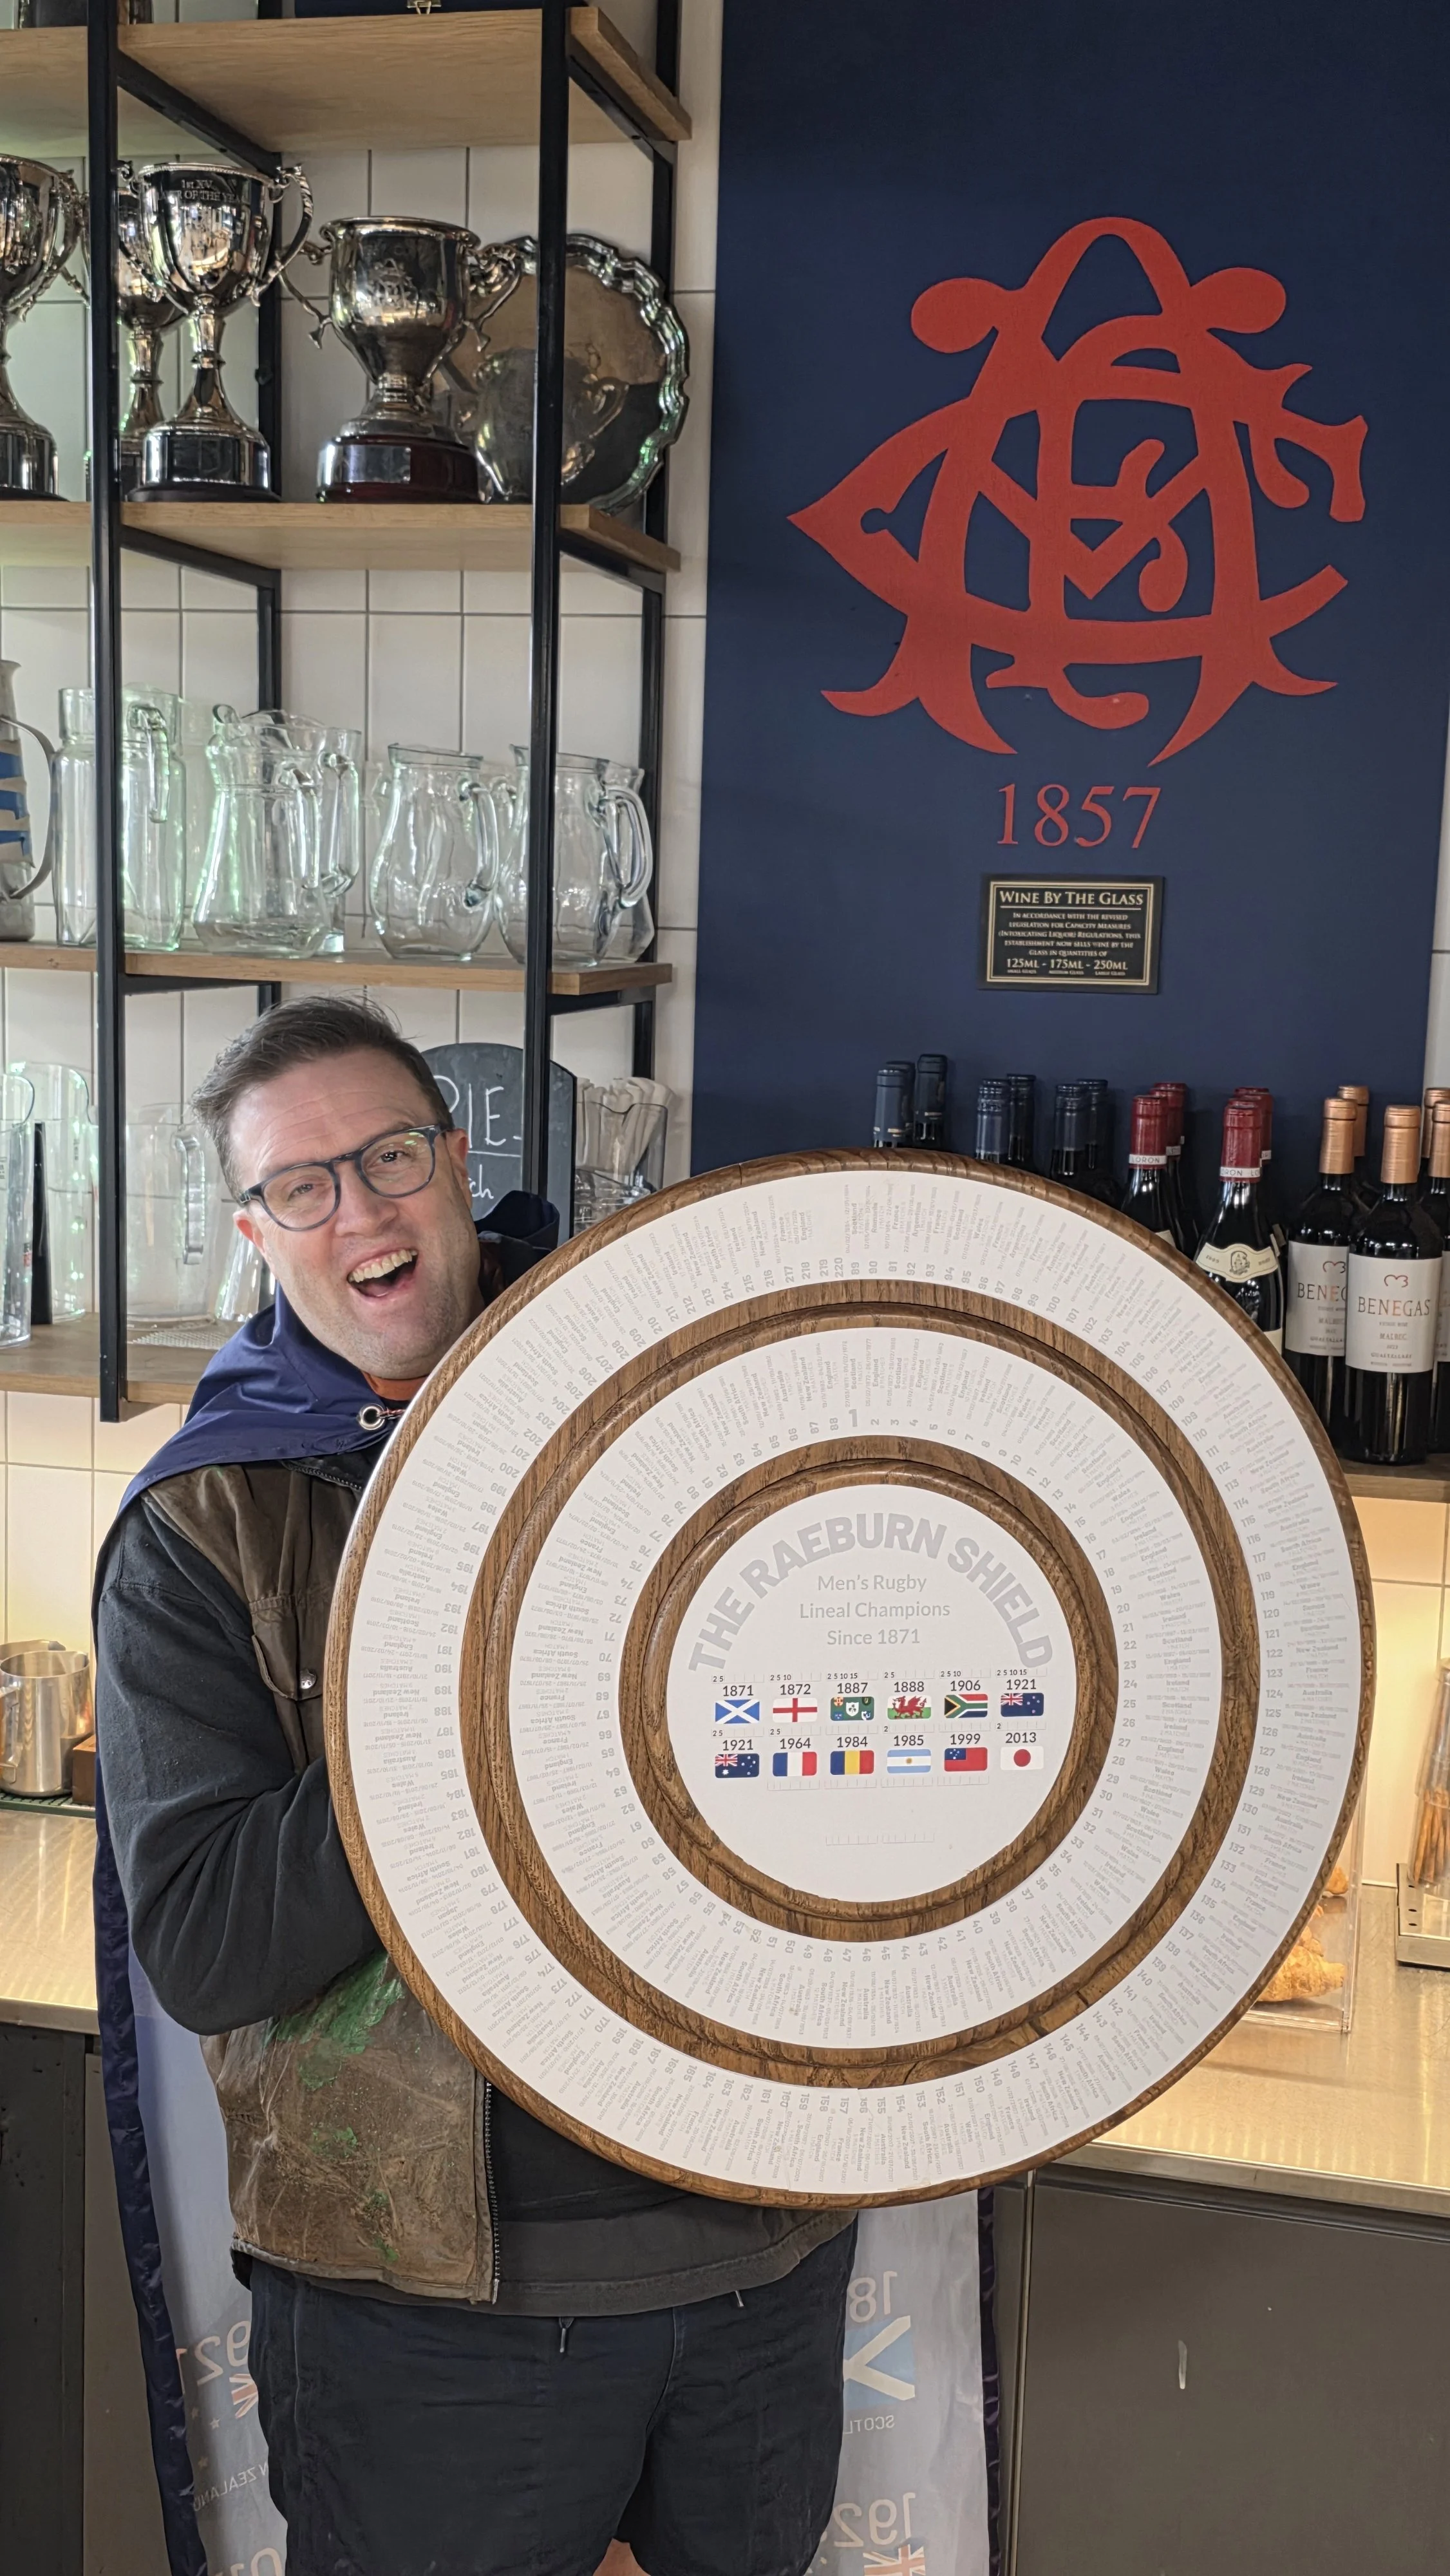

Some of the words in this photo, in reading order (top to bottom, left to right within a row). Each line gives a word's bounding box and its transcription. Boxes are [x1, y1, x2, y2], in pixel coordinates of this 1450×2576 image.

[200, 191, 220, 201] THE
[997, 783, 1161, 848] 1857
[1000, 891, 1039, 904] WINE
[1044, 891, 1062, 904] BY
[1065, 891, 1095, 905] THE
[1099, 892, 1143, 905] GLASS
[801, 1262, 811, 1280] 218
[819, 1260, 828, 1276] 219
[834, 1258, 843, 1278] 220
[851, 1262, 860, 1274] 89
[869, 1261, 878, 1274] 90
[907, 1263, 916, 1275] 92
[764, 1270, 774, 1287] 216
[784, 1266, 794, 1283] 217
[721, 1282, 733, 1300] 214
[1297, 1283, 1346, 1302] BENE
[1357, 1296, 1431, 1317] BENEGAS
[1142, 1367, 1158, 1382] 106
[471, 1521, 489, 1535] 197
[629, 1560, 643, 1572] 75
[451, 1582, 468, 1595] 194
[818, 1575, 869, 1590] Men's
[874, 1574, 927, 1593] Rugby
[688, 1587, 754, 1672] THE
[739, 1512, 947, 1599] RAEBURN
[947, 1537, 1053, 1669] SHIELD
[800, 1602, 850, 1618] Lineal
[855, 1601, 950, 1620] Champions
[827, 1630, 872, 1645] Since
[878, 1629, 919, 1643] 1871
[599, 1653, 612, 1662] 70
[1266, 1669, 1283, 1678] 123
[723, 1685, 753, 1696] 1871
[780, 1684, 811, 1695] 1872
[838, 1683, 868, 1694] 1887
[894, 1681, 924, 1692] 1888
[950, 1680, 981, 1691] 1906
[1007, 1679, 1036, 1690] 1921
[1124, 1680, 1137, 1689] 24
[1266, 1690, 1283, 1698] 124
[780, 1738, 811, 1749] 1964
[837, 1736, 867, 1747] 1984
[894, 1735, 923, 1746] 1985
[950, 1734, 980, 1745] 1999
[1006, 1732, 1036, 1743] 2013
[1118, 1738, 1131, 1747] 27
[723, 1739, 753, 1750] 1921
[490, 1900, 508, 1915] 178
[525, 1949, 541, 1964] 175
[804, 1945, 813, 1958] 49
[955, 2082, 965, 2097] 151
[974, 2076, 984, 2092] 150
[896, 2094, 905, 2112] 154
